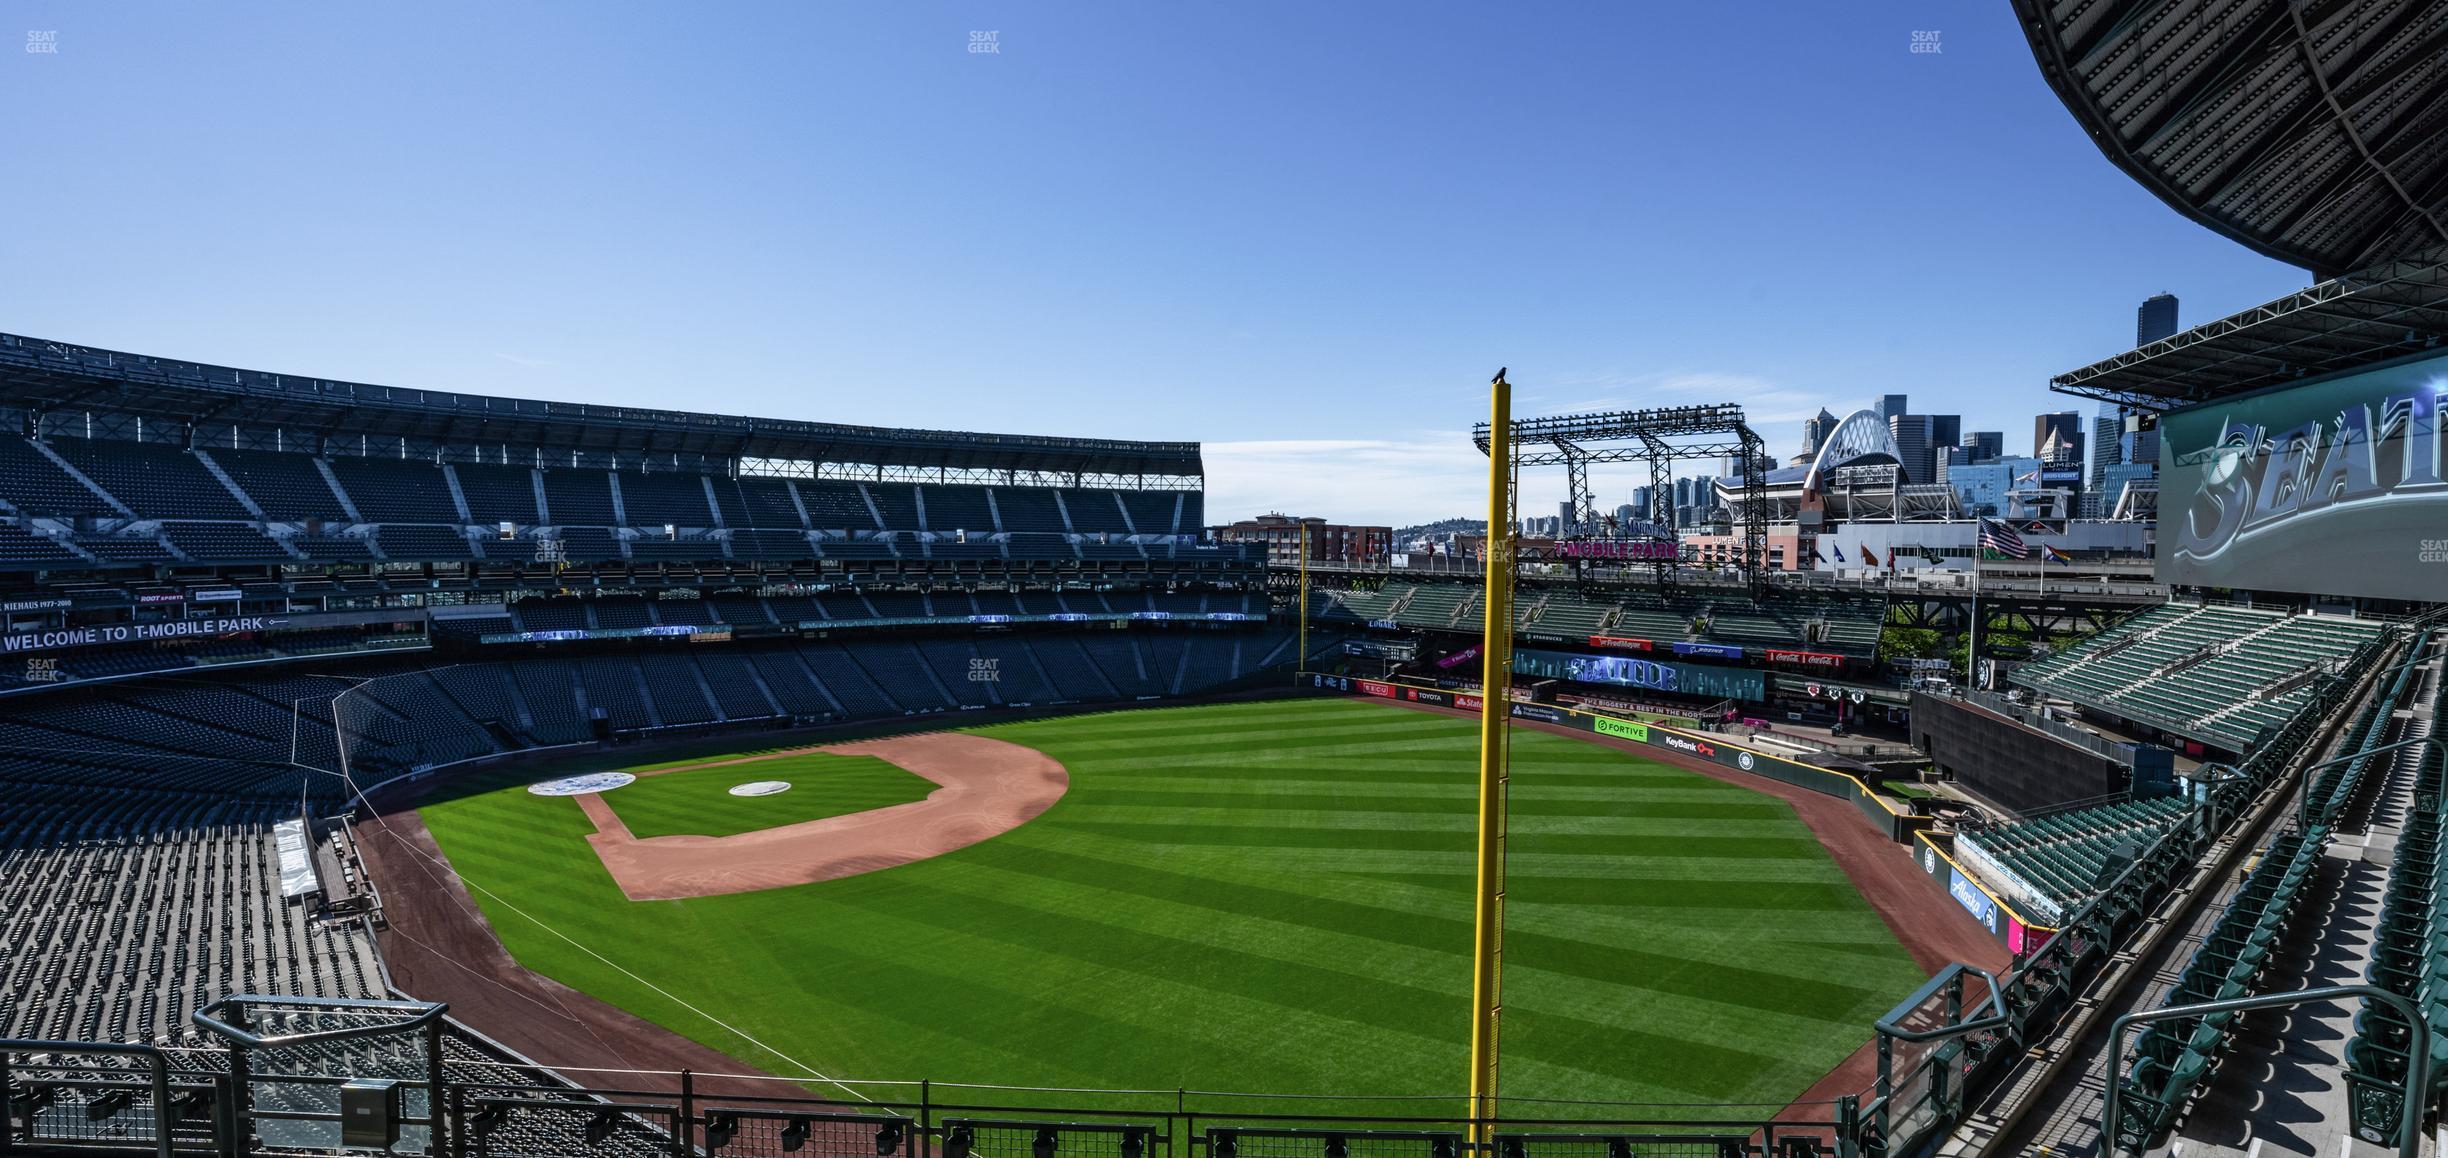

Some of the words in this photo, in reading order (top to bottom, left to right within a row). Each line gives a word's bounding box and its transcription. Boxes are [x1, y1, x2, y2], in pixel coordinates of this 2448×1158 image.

[1712, 536, 1739, 545] LUMEN
[1555, 541, 1628, 558] T-MOBILE
[1632, 542, 1680, 558] PARK
[4, 601, 39, 611] NIEHAUS
[3, 628, 97, 651] WELCOME
[102, 626, 128, 641] TO
[134, 620, 214, 639] T-MOBILE
[219, 617, 263, 631] PARK
[1532, 634, 1563, 642] STARBUCKS
[1365, 684, 1388, 694] BECU
[1418, 692, 1442, 701] TOYOTA
[1466, 699, 1484, 709] State
[1666, 708, 1680, 716] THE
[1608, 723, 1644, 737] FORTIVE
[1665, 735, 1697, 752] KeyBank
[1952, 880, 1981, 914] Alaska
